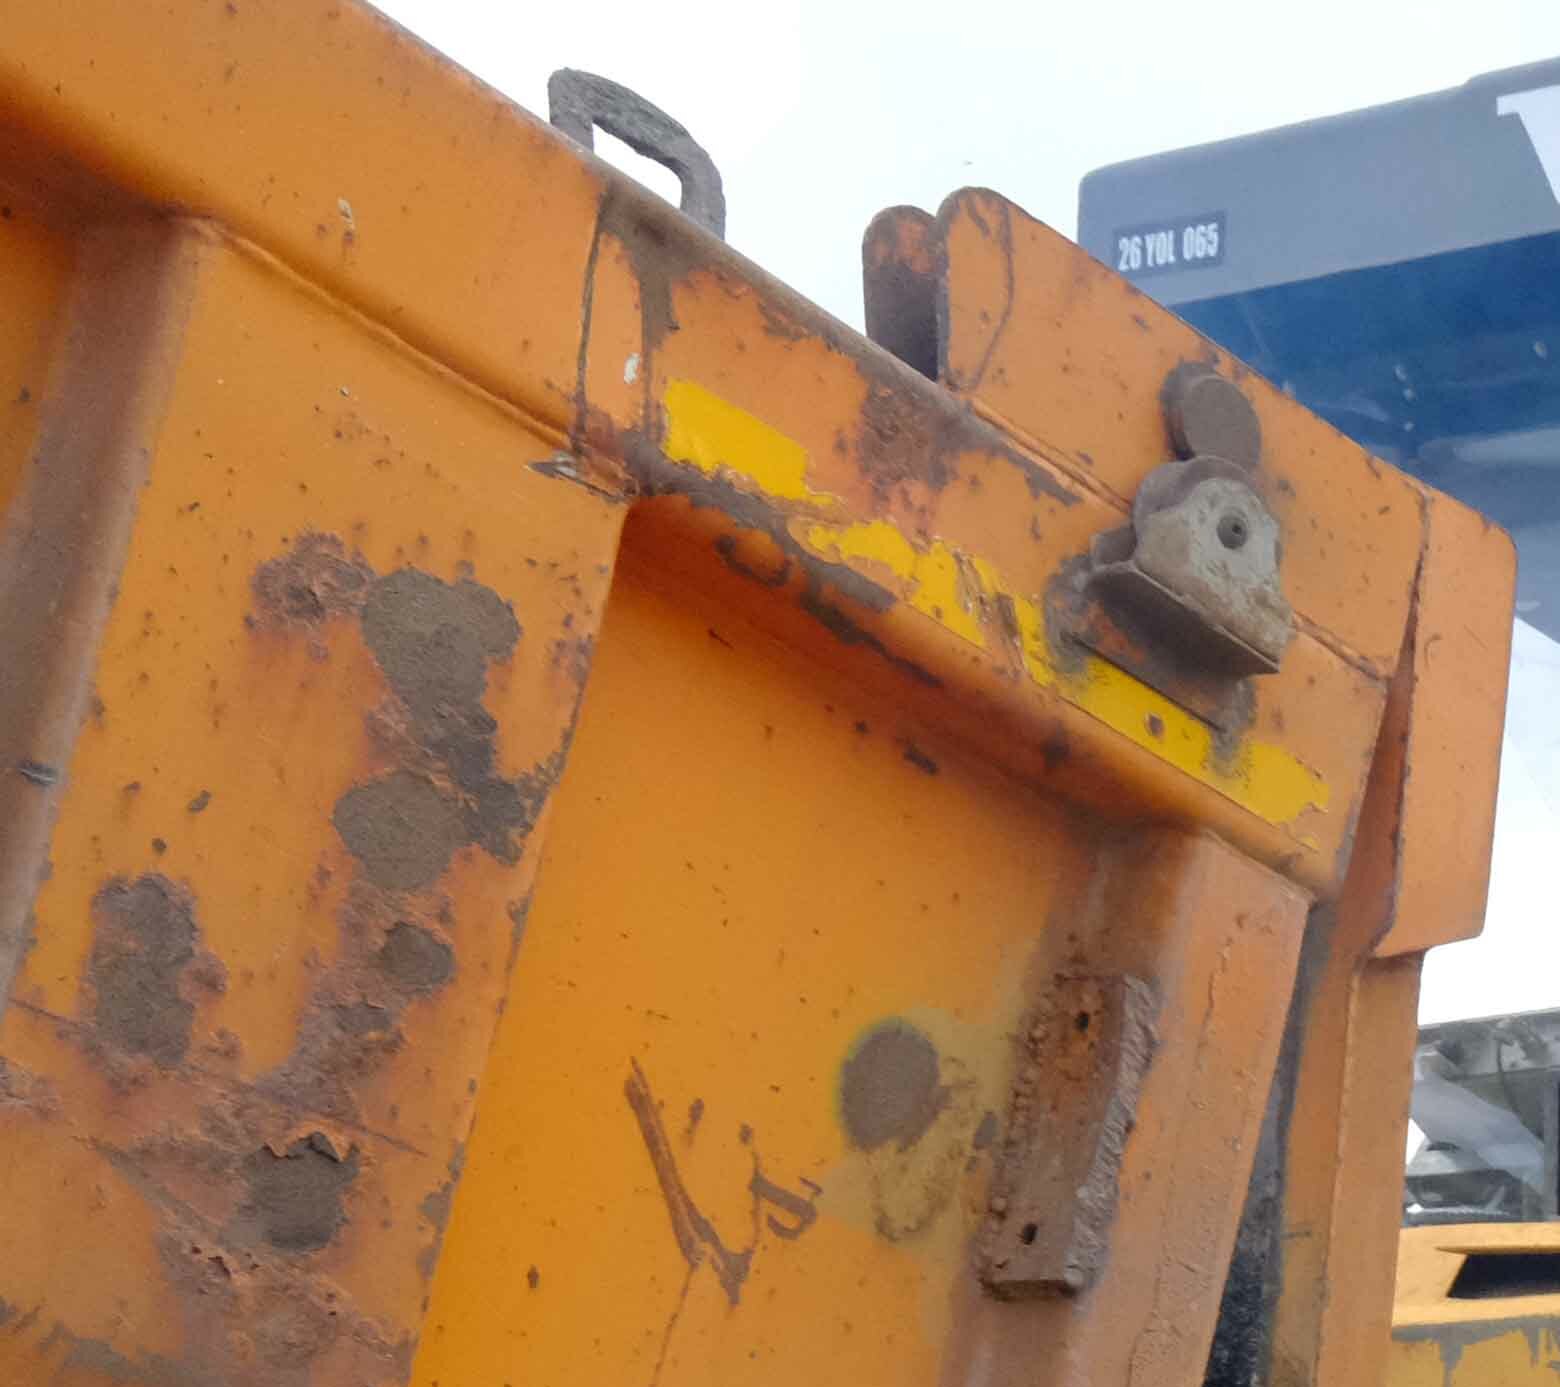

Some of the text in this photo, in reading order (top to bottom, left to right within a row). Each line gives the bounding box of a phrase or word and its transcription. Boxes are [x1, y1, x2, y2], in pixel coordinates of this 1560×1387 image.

[1118, 222, 1219, 272] 26 YOL 065
